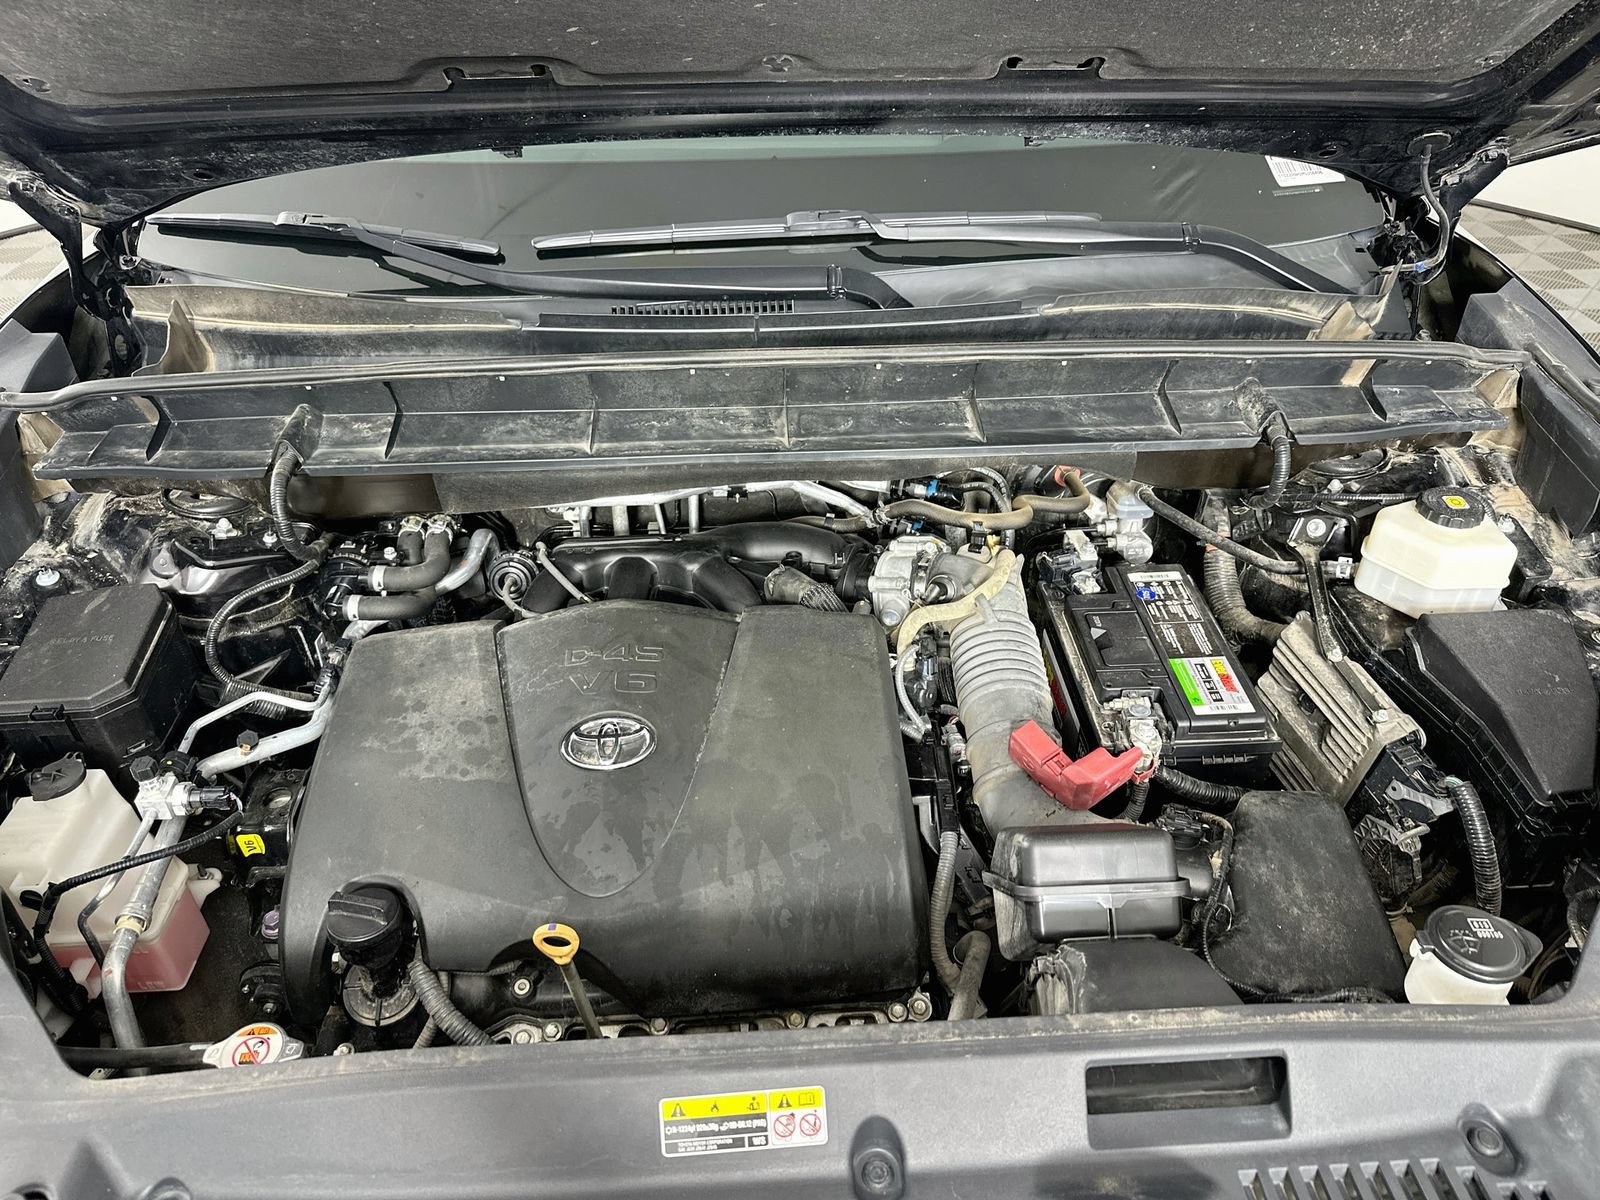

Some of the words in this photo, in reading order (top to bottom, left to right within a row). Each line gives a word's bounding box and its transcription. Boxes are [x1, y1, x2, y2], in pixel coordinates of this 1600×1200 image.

[565, 644, 665, 667] D-4S
[569, 670, 658, 695] V6
[244, 839, 257, 853] V6
